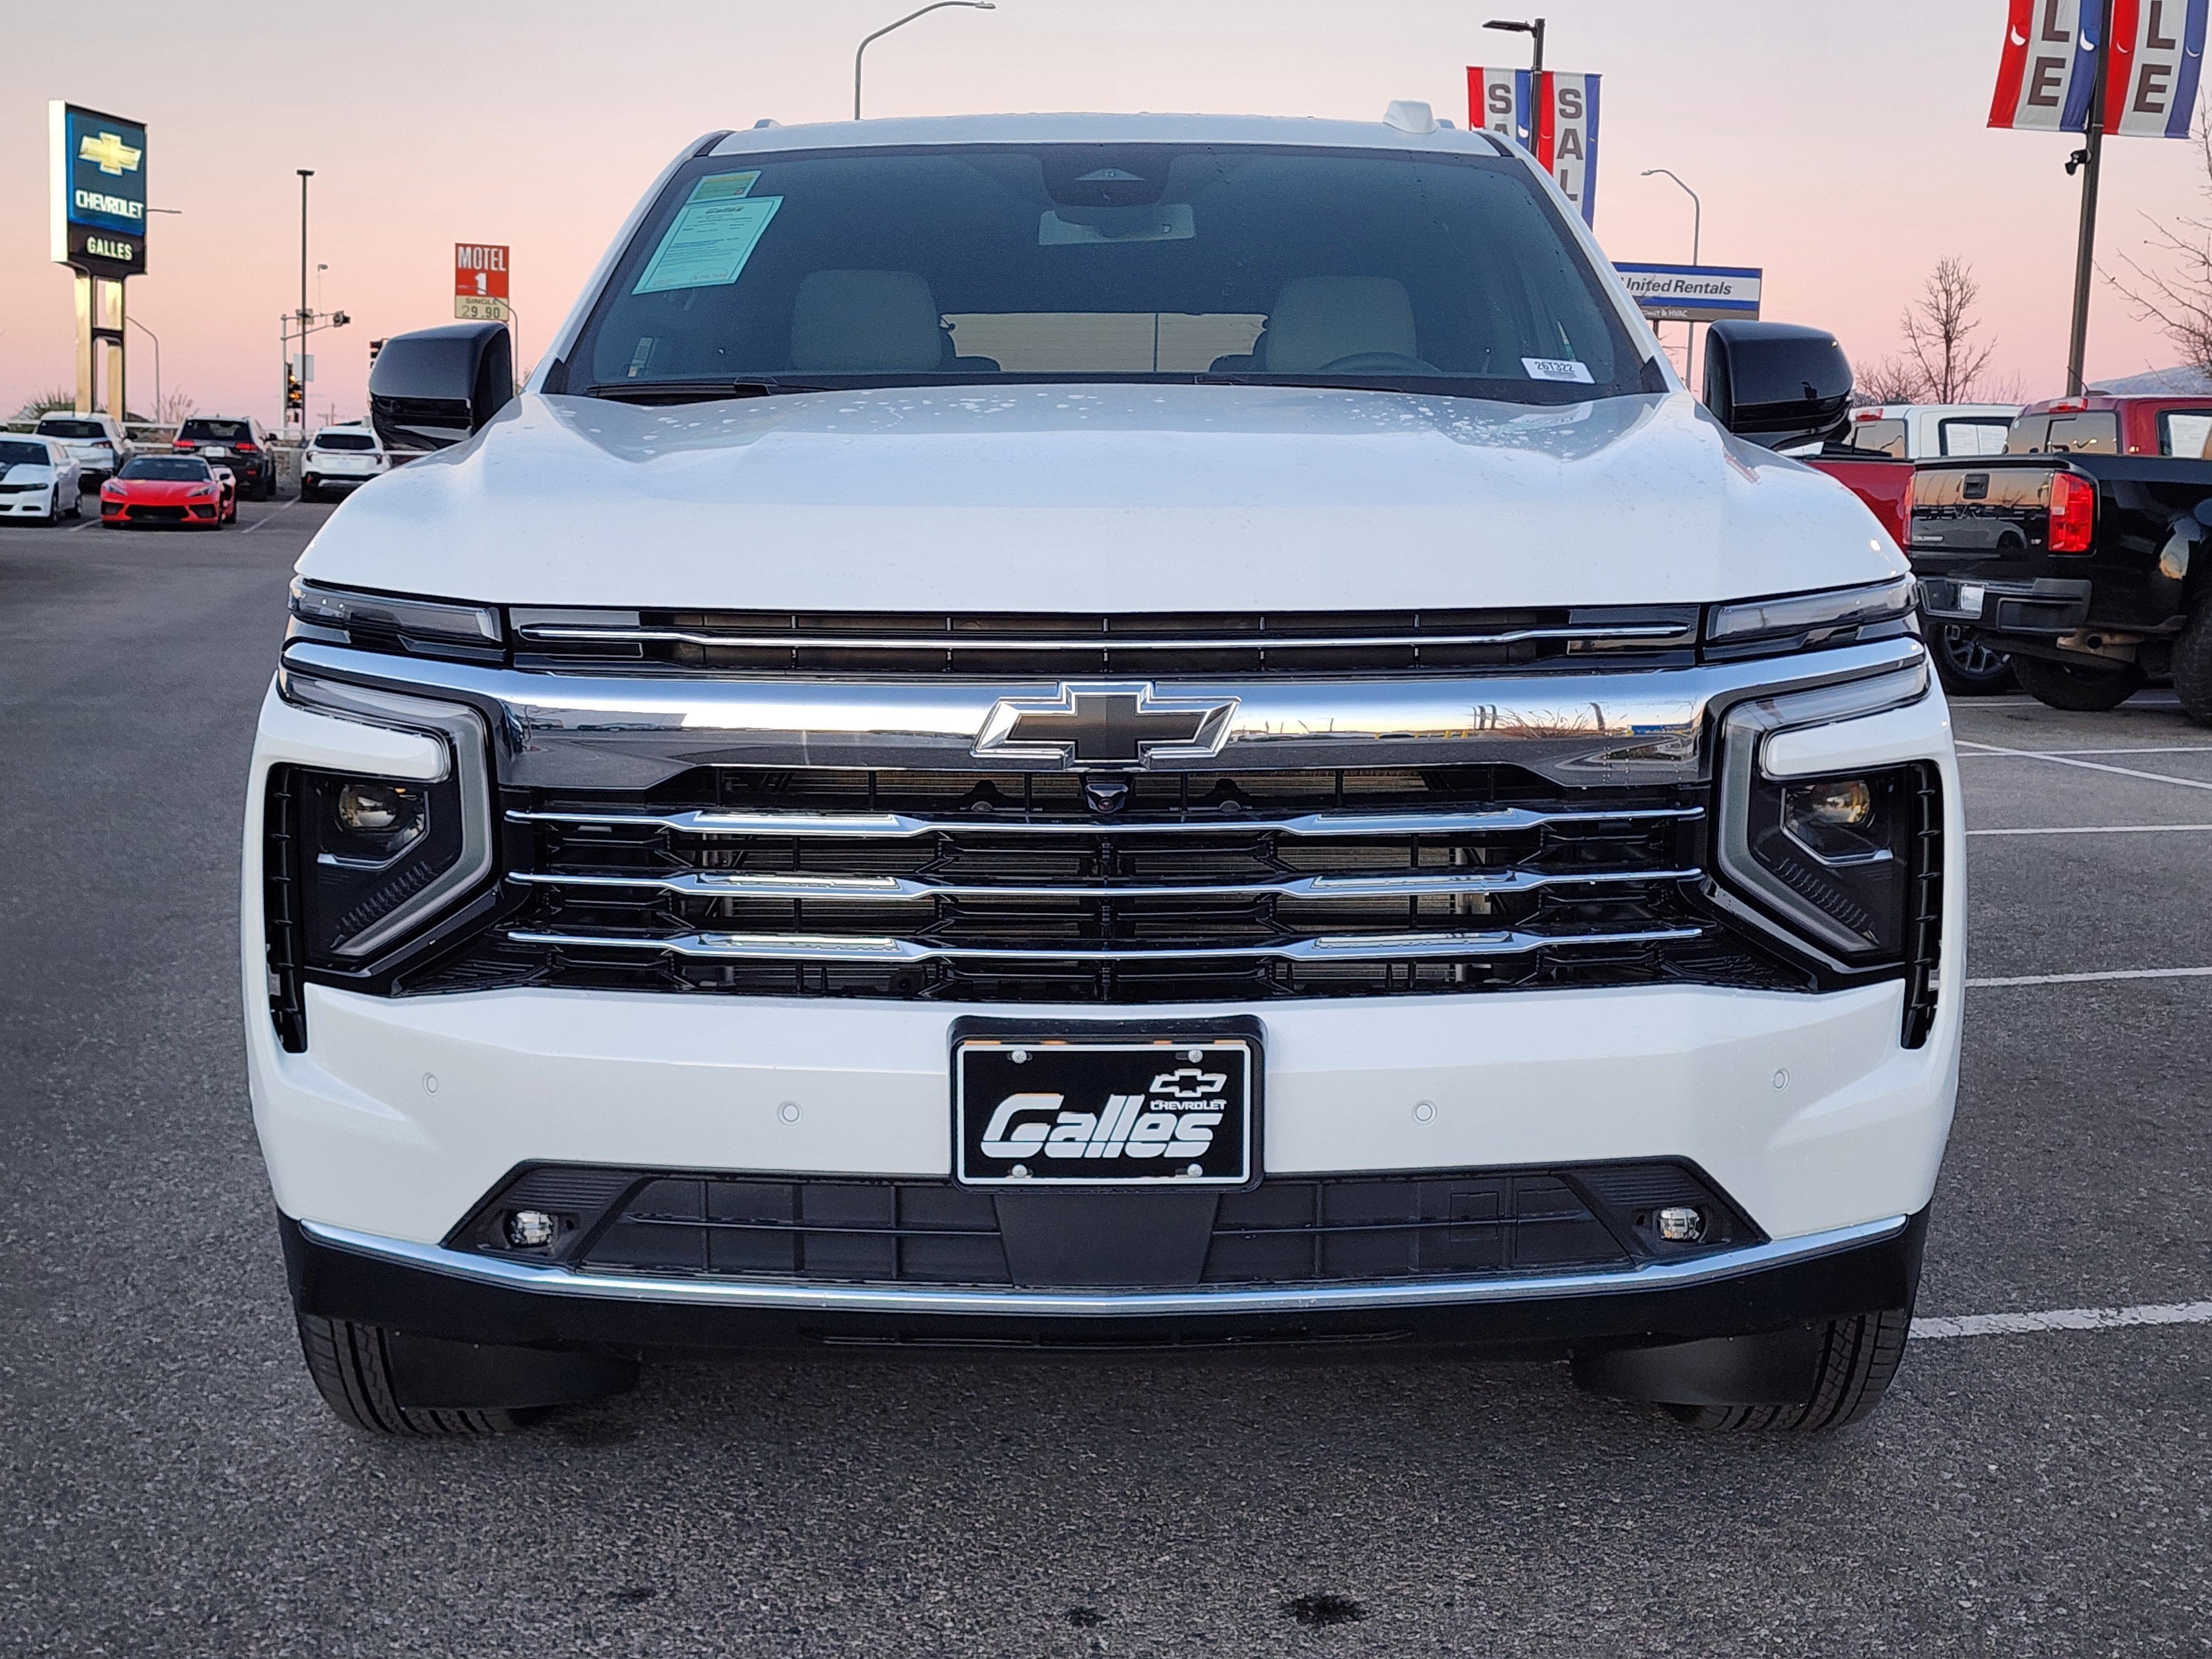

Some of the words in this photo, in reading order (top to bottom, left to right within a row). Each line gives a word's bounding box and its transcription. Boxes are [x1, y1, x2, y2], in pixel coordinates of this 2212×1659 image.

[2027, 0, 2070, 107] LE
[2132, 0, 2176, 113] LE
[75, 189, 144, 219] CHEVROLET
[86, 236, 133, 261] GALLES
[458, 246, 507, 272] MOTEL
[475, 273, 487, 295] 1
[1673, 279, 1733, 295] Rentals
[462, 305, 500, 319] 29.90
[1150, 1099, 1227, 1110] CHEVROLET
[980, 1093, 1223, 1158] Galles
